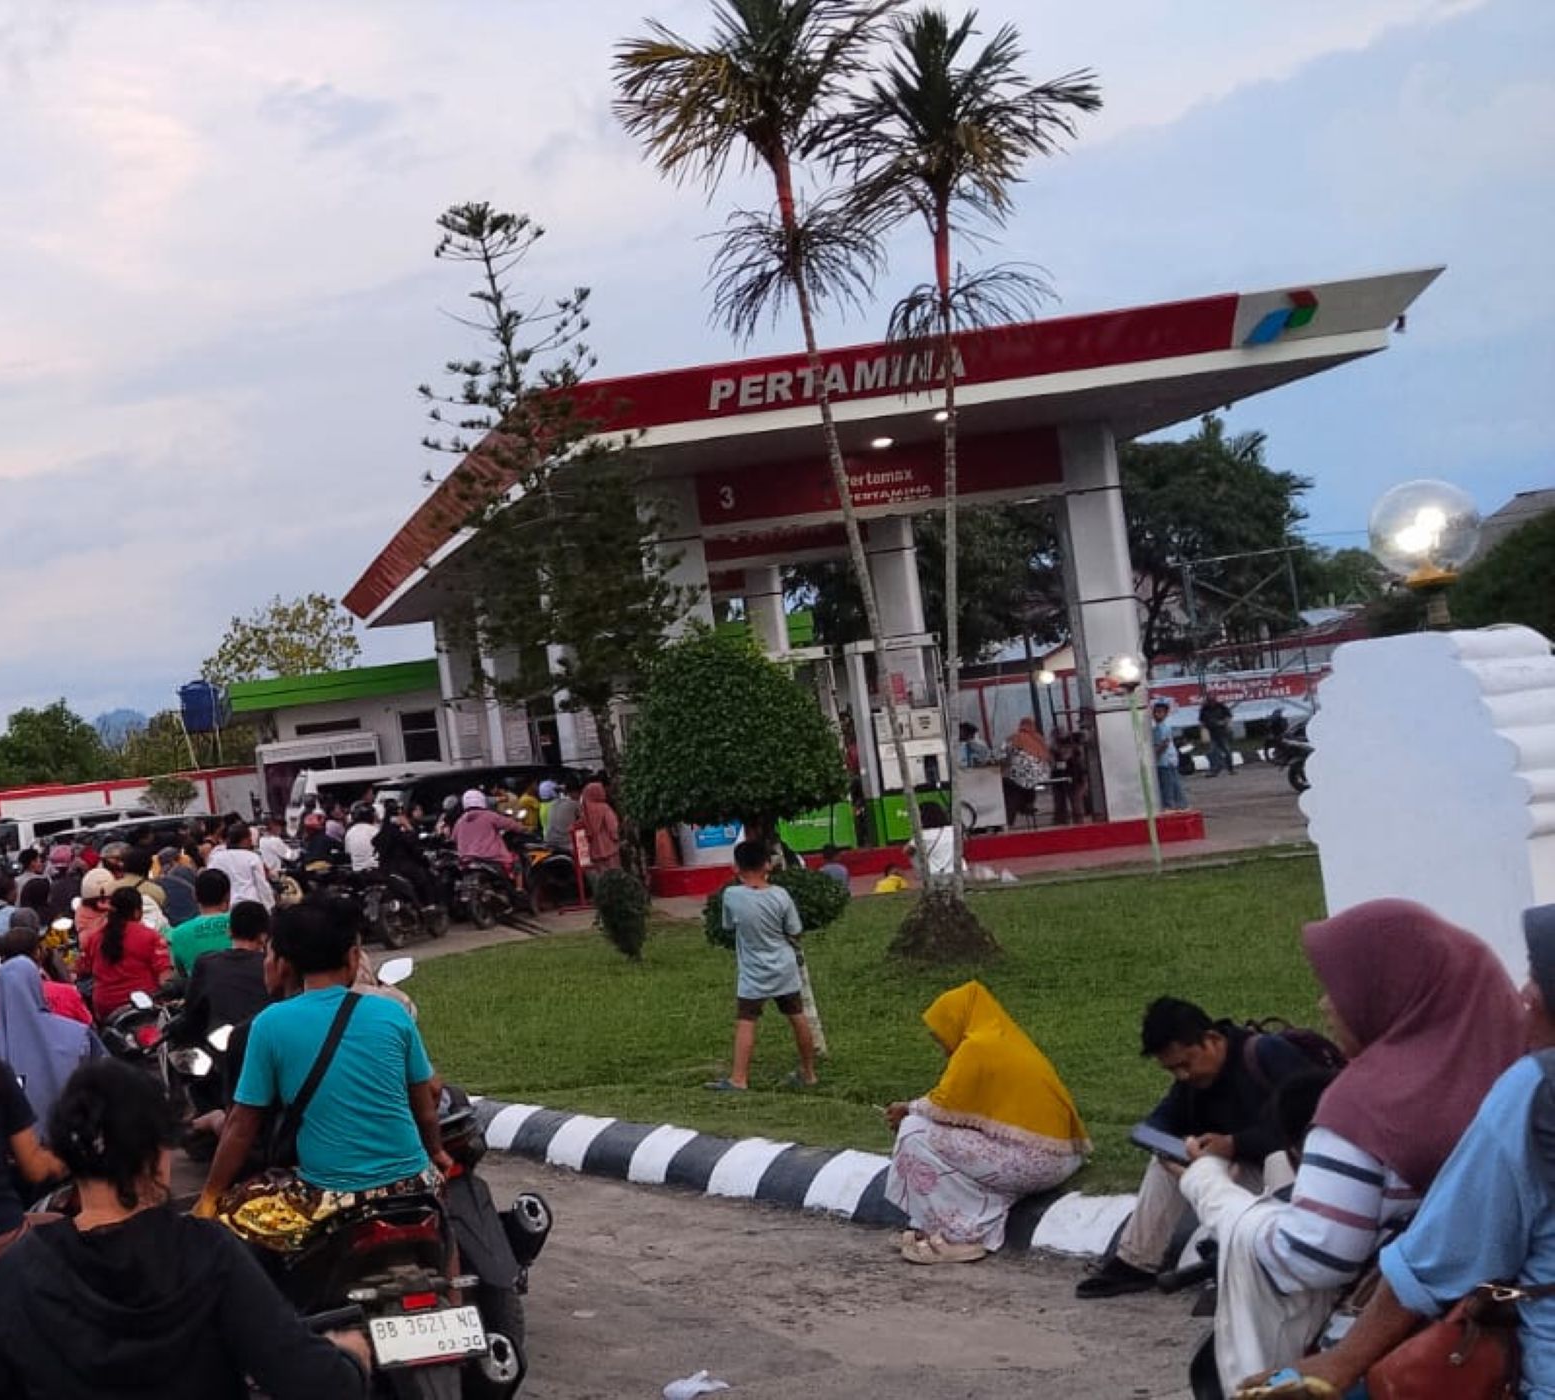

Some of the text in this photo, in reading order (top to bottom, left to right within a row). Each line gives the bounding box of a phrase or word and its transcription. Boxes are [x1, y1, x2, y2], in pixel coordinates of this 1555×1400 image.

[708, 349, 965, 410] PERTAMINA
[719, 486, 735, 509] 3
[375, 1321, 398, 1340] BB
[405, 1316, 447, 1336] 3621
